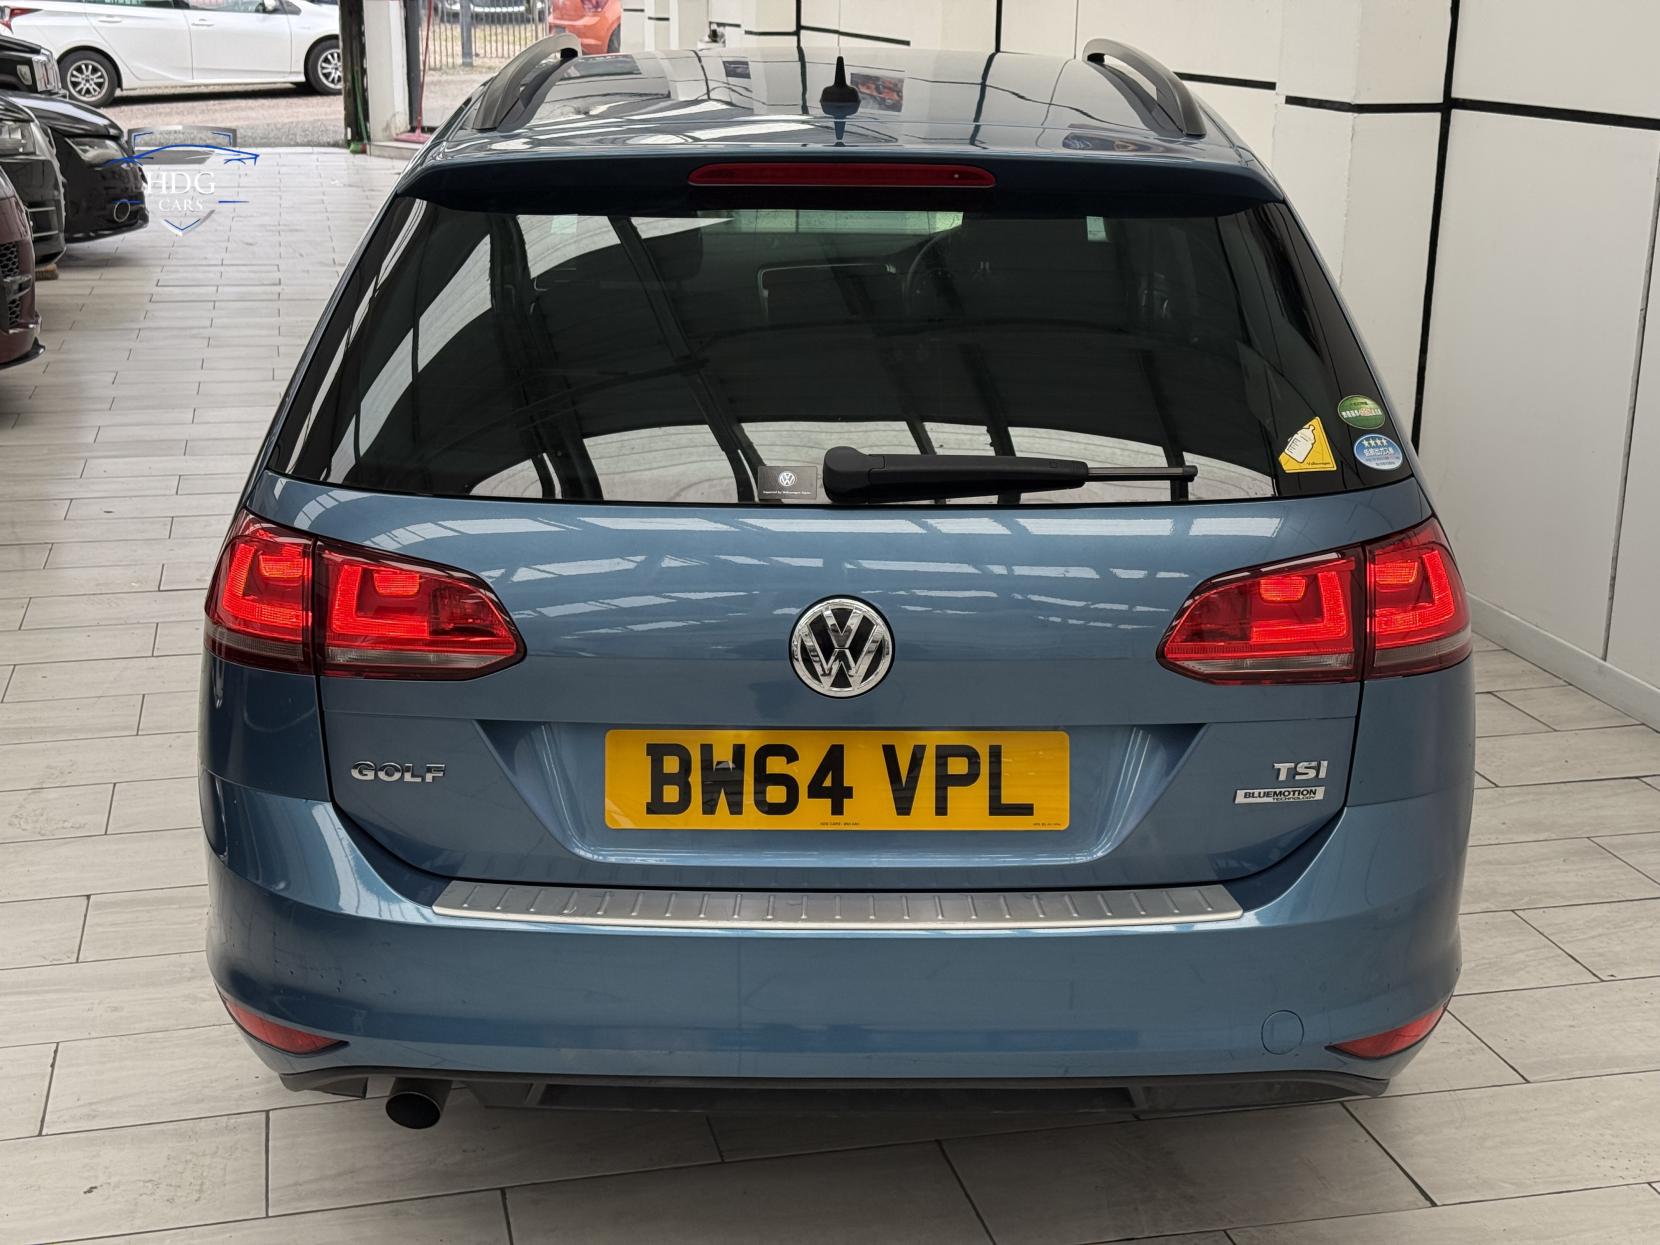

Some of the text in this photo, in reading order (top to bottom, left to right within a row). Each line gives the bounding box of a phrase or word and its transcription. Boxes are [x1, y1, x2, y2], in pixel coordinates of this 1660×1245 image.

[793, 598, 889, 697] VW
[350, 761, 446, 783] GOLF
[645, 743, 1035, 817] BW64 VPL
[1273, 760, 1329, 781] TSI
[1243, 788, 1317, 799] BLUEMOTION
